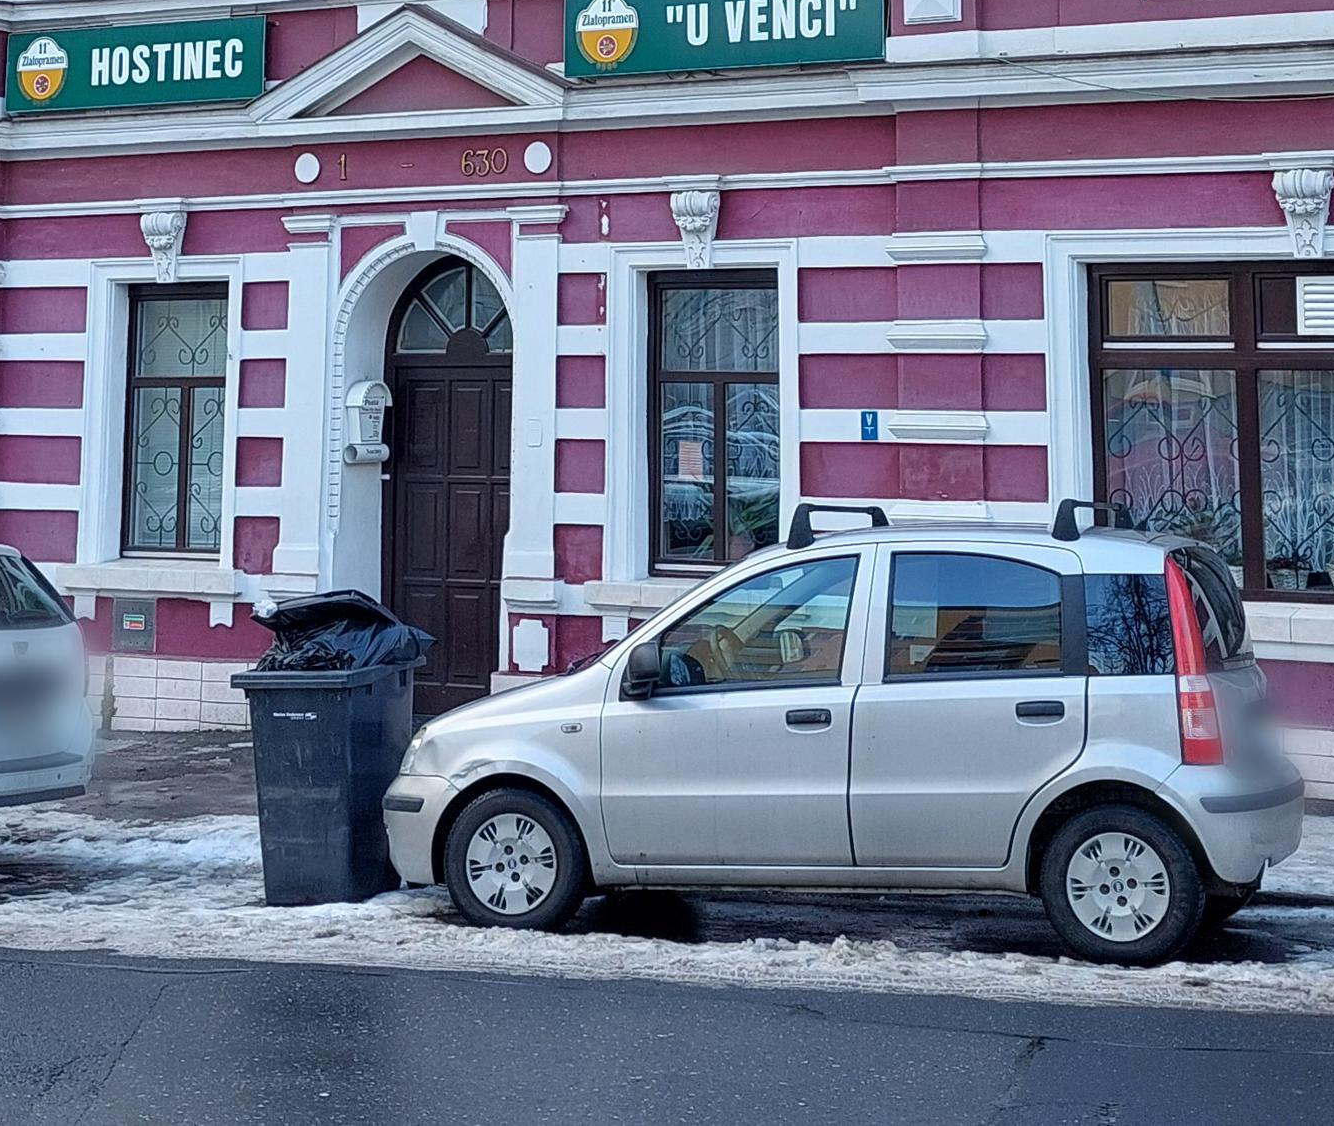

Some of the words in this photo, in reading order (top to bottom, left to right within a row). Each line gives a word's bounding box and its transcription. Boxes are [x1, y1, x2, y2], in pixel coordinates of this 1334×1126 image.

[581, 14, 635, 28] Zlatopramen
[666, 3, 709, 46] "U
[90, 38, 244, 86] HOSTINEC
[337, 153, 348, 181] 1
[460, 147, 509, 177] 630
